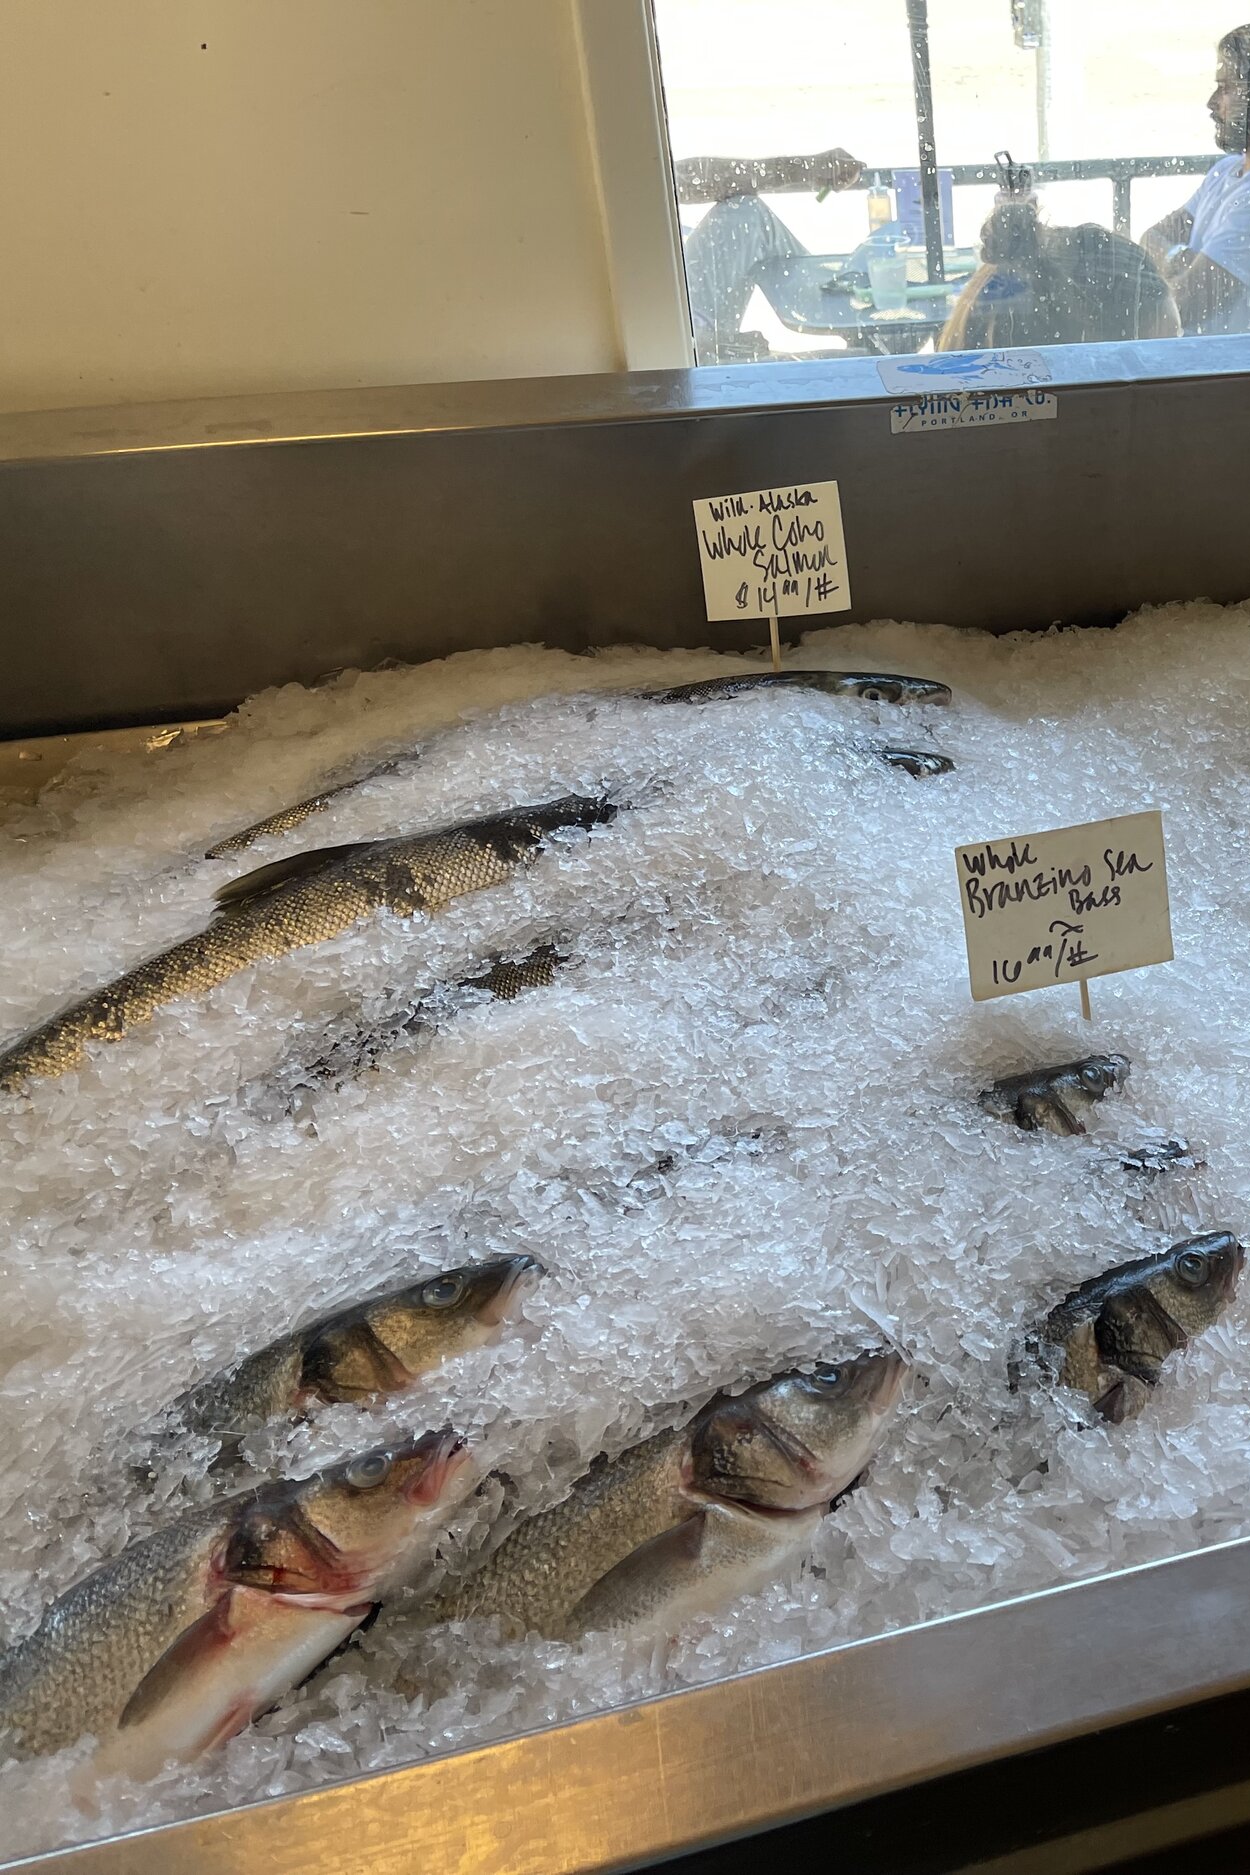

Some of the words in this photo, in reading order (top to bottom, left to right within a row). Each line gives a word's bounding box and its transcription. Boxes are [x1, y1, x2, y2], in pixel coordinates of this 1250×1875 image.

[1011, 410, 1028, 418] OR
[759, 488, 818, 514] Alaska
[702, 525, 766, 560] Whole
[772, 514, 824, 551] Coho
[753, 544, 838, 582] Salmon
[1104, 849, 1153, 881] Sea
[1069, 886, 1122, 915] Bass
